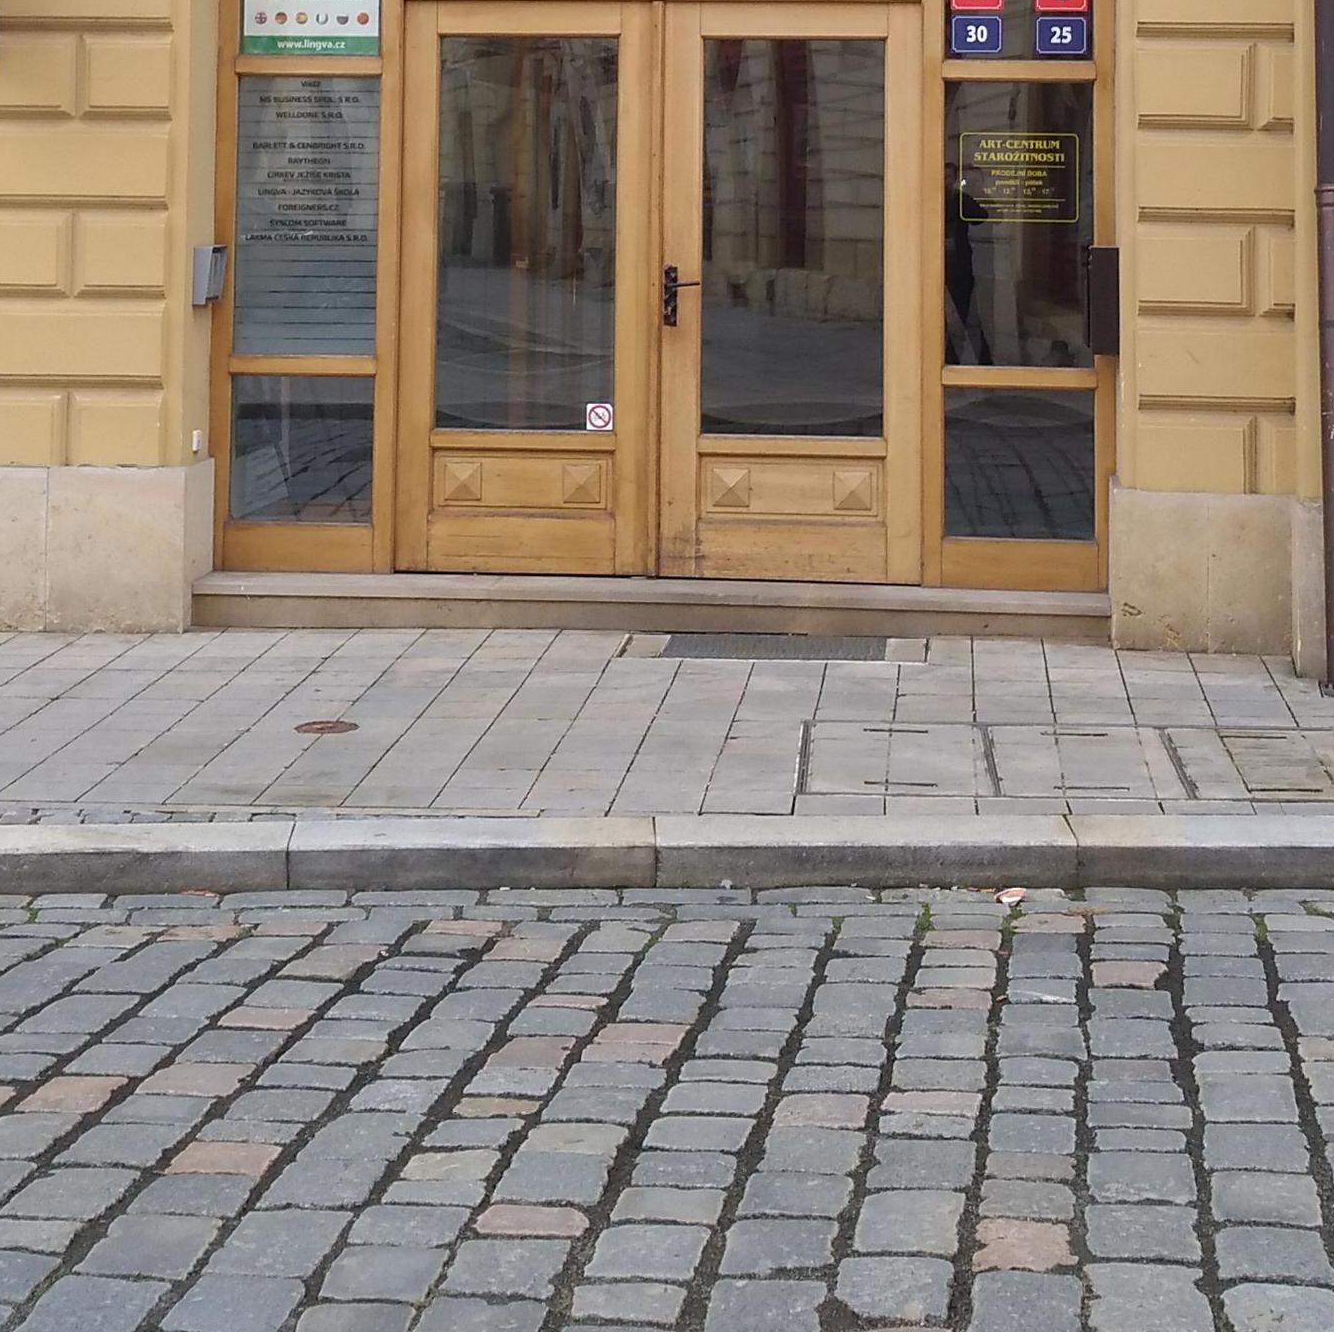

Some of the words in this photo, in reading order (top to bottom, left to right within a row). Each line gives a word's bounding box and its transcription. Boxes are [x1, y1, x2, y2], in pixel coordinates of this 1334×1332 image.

[966, 25, 988, 43] 30
[1050, 26, 1072, 44] 25
[276, 39, 347, 51] www.lingva.cz
[978, 139, 1061, 150] ART-CENTRUM
[287, 157, 331, 165] RAYTHEON
[973, 151, 1065, 162] STAROŽITNOSTI
